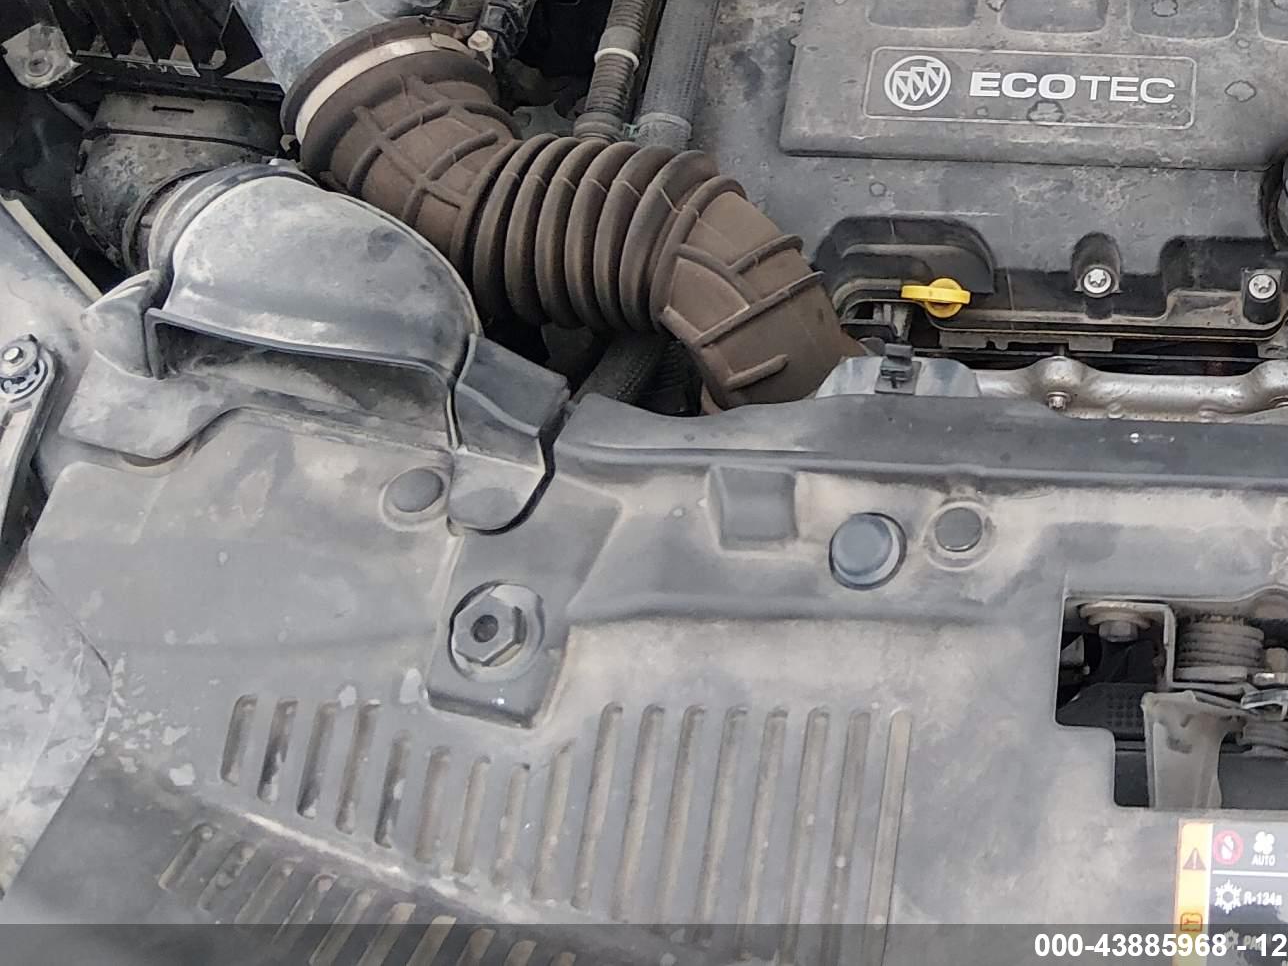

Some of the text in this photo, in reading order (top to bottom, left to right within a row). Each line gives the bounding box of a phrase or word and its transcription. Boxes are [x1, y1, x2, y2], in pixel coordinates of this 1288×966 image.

[969, 72, 1176, 104] ECOTEC
[1251, 855, 1276, 866] AUTO
[1243, 889, 1283, 906] R-134a
